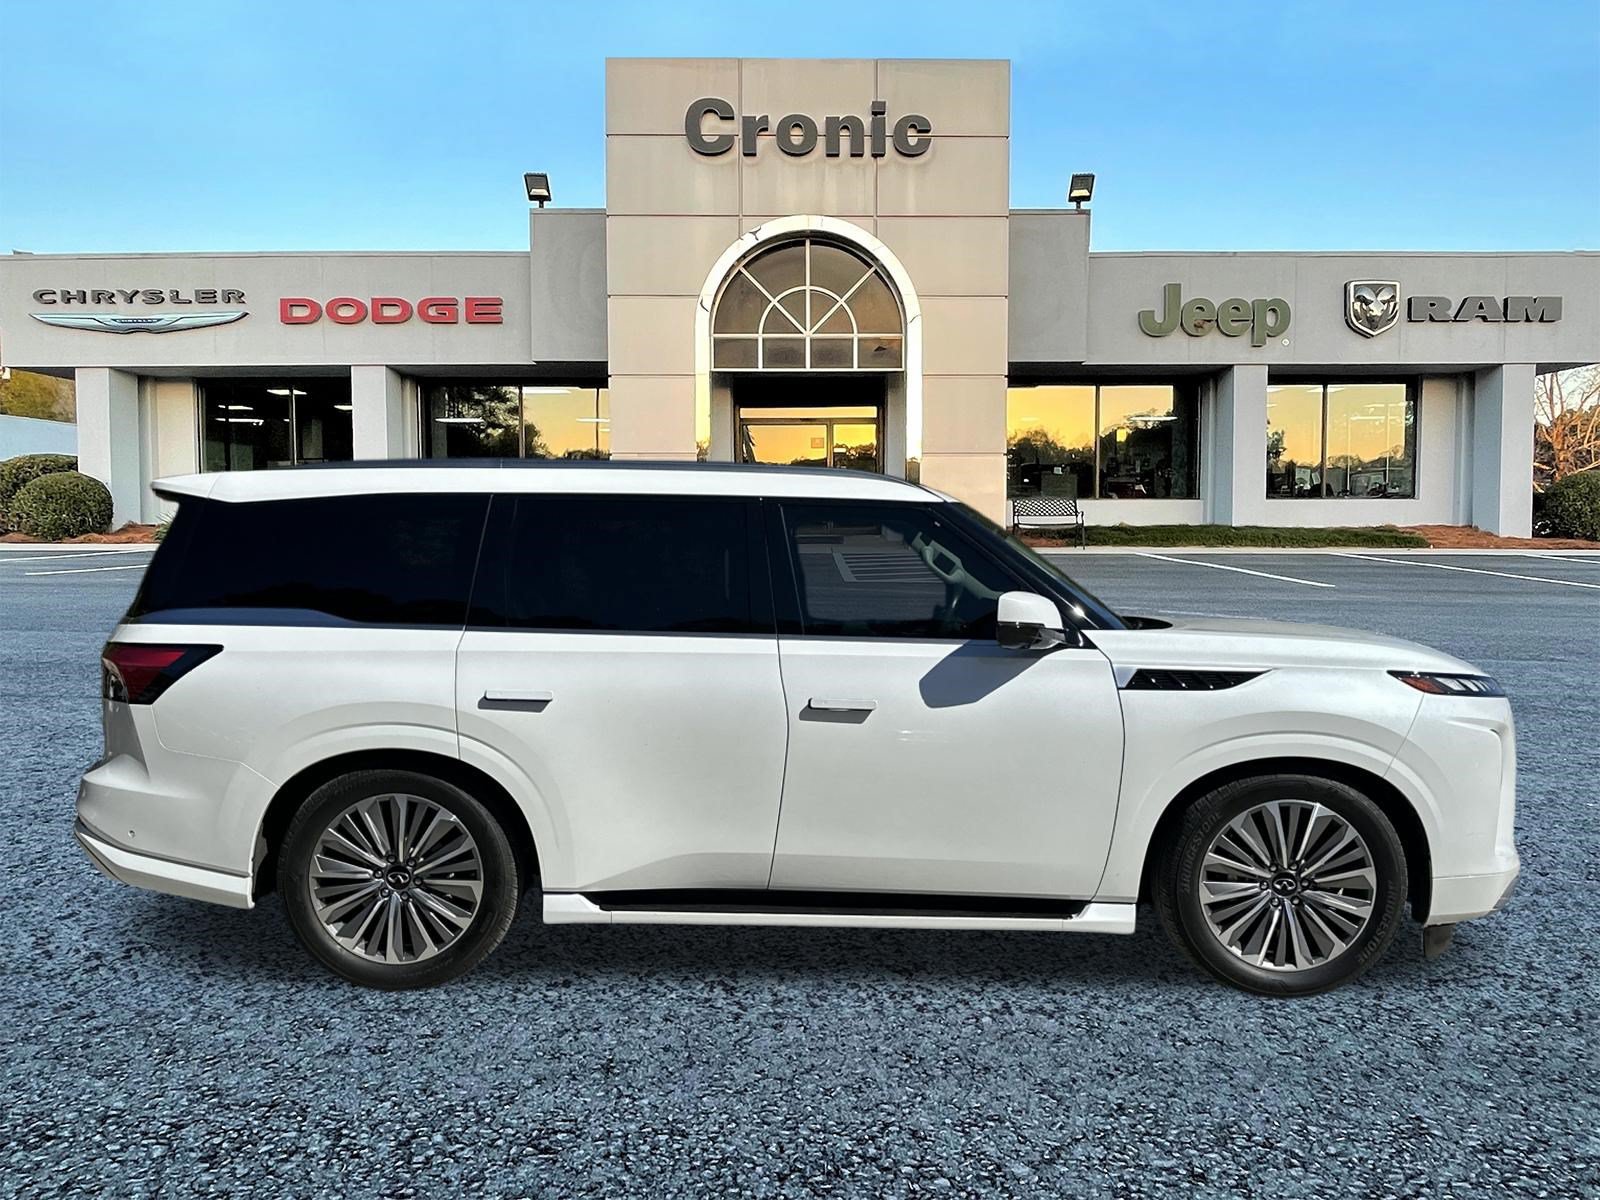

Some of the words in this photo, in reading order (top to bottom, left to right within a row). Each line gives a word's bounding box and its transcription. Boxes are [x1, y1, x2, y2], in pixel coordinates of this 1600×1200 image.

[685, 97, 932, 157] Cronic
[32, 289, 246, 304] CHRYSLER
[1407, 296, 1563, 322] RAM
[280, 297, 503, 324] DODGE
[1138, 283, 1291, 347] Jeep
